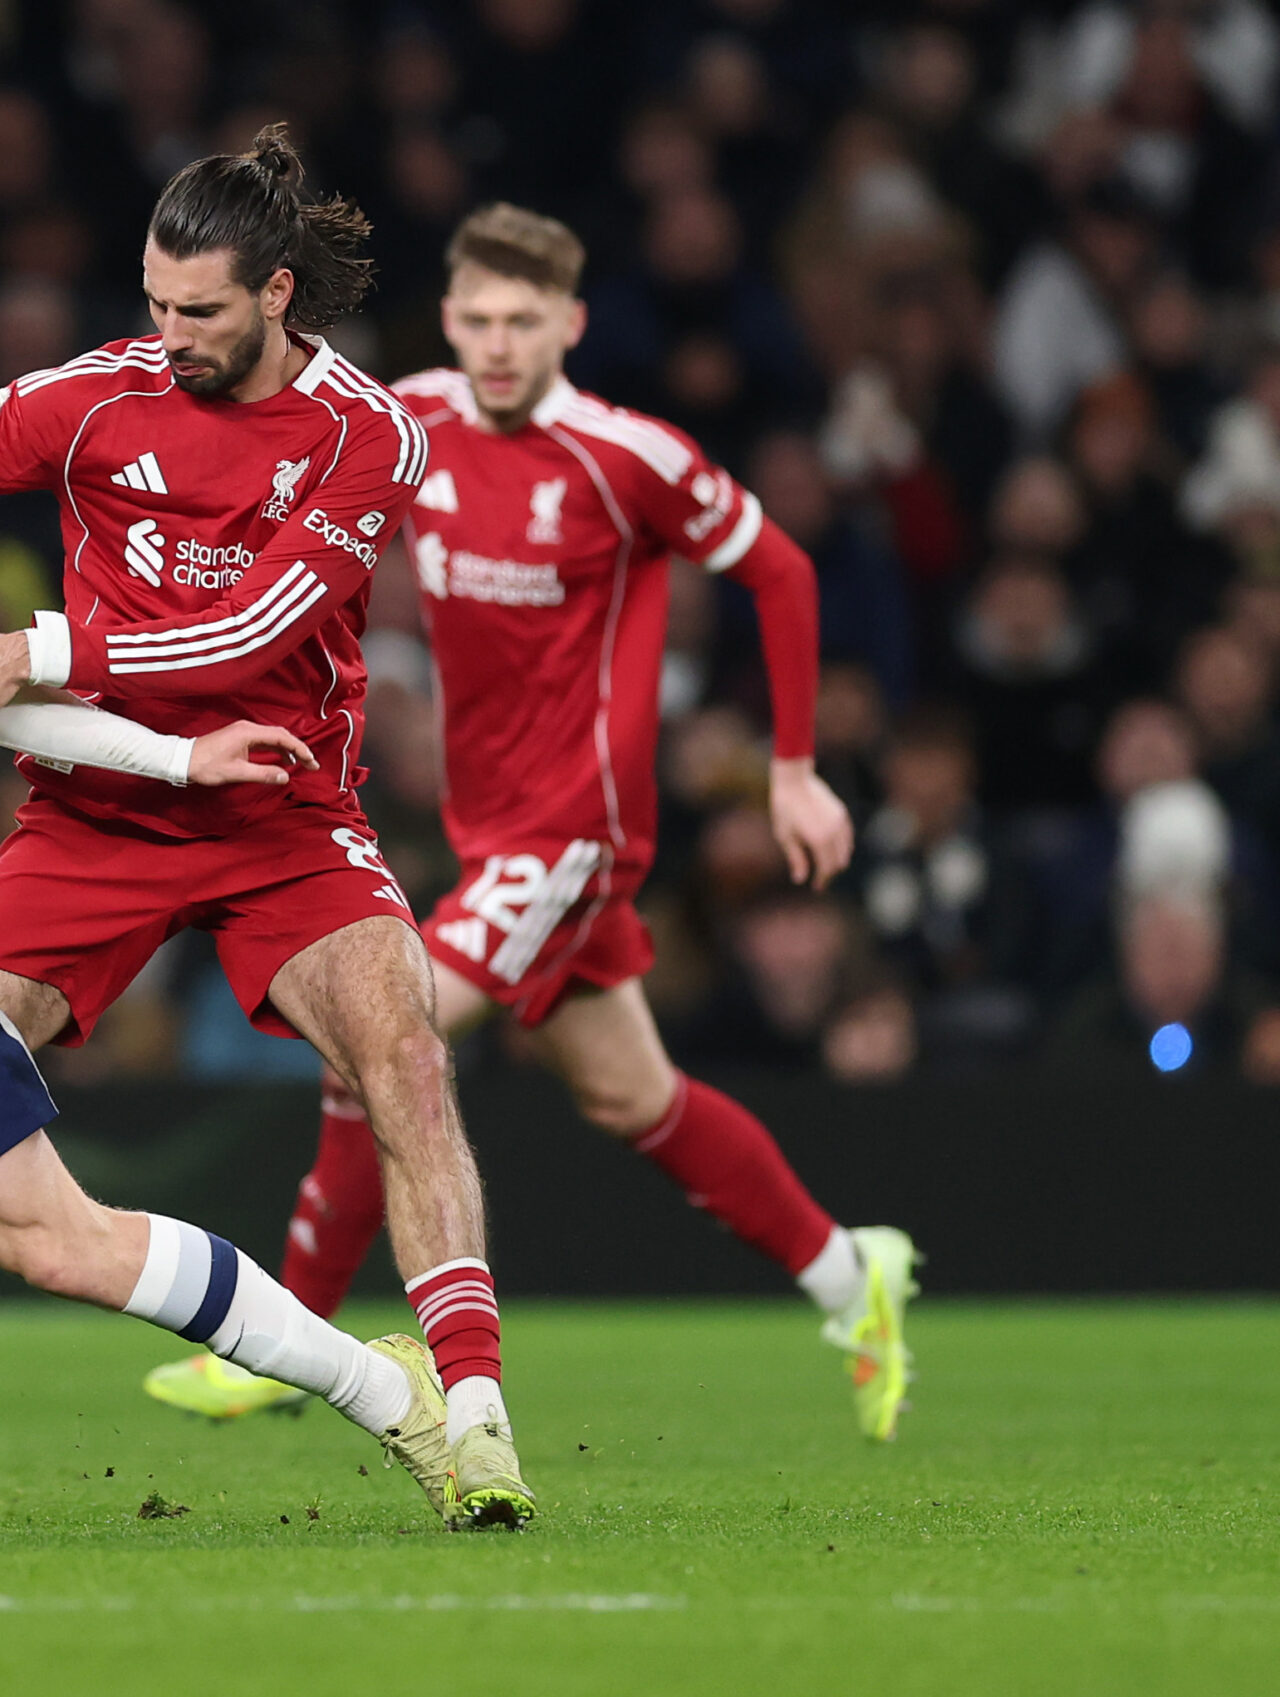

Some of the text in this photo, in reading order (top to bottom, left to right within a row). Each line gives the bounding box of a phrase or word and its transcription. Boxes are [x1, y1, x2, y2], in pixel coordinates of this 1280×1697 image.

[175, 538, 261, 569] standa
[172, 563, 244, 589] charte
[331, 827, 396, 881] 8
[459, 853, 548, 936] 12
